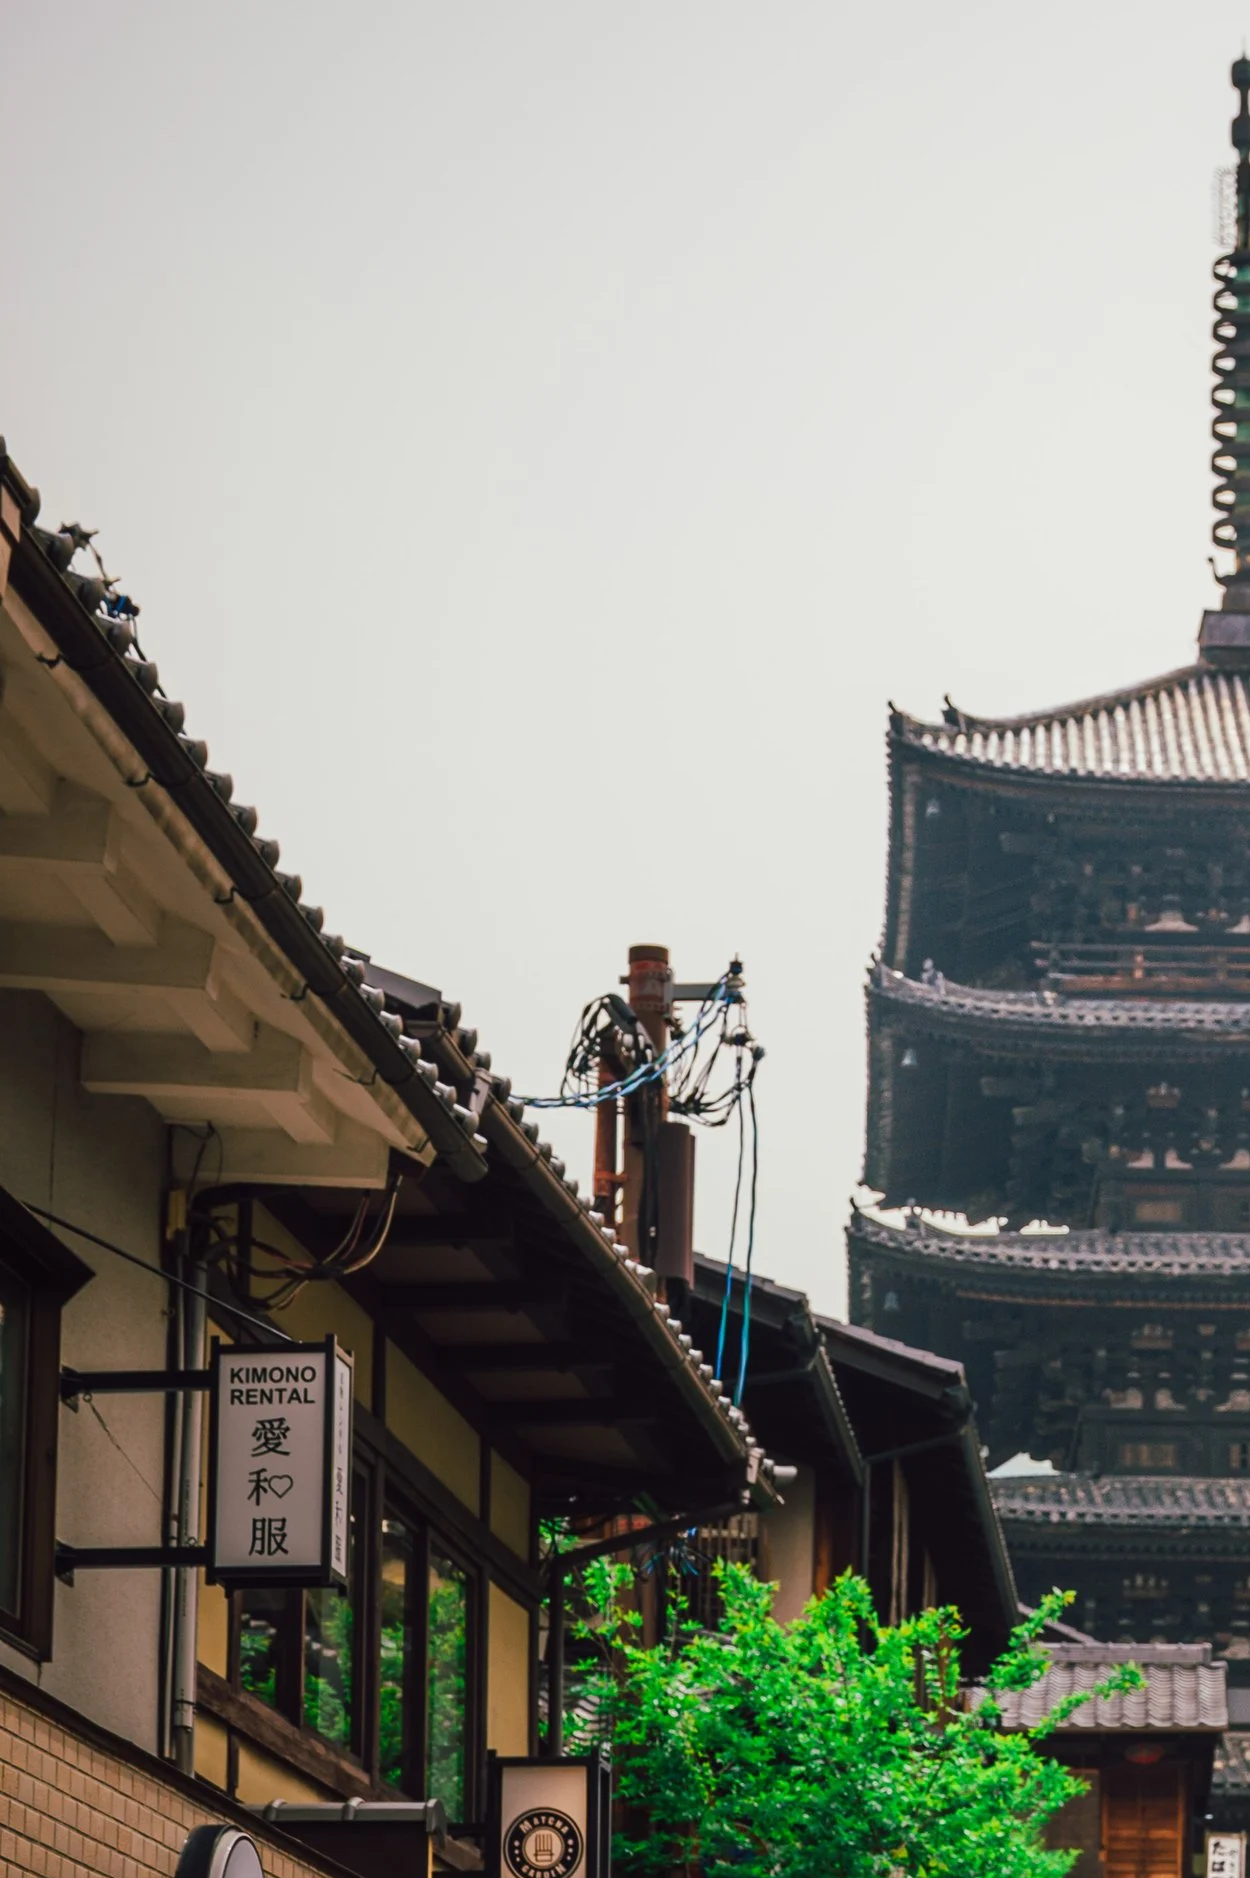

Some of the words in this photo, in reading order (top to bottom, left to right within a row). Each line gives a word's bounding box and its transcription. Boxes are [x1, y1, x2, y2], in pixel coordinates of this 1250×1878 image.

[230, 1366, 316, 1384] KIMONO
[230, 1388, 315, 1405] RENTAL
[519, 1815, 570, 1836] MATCHA
